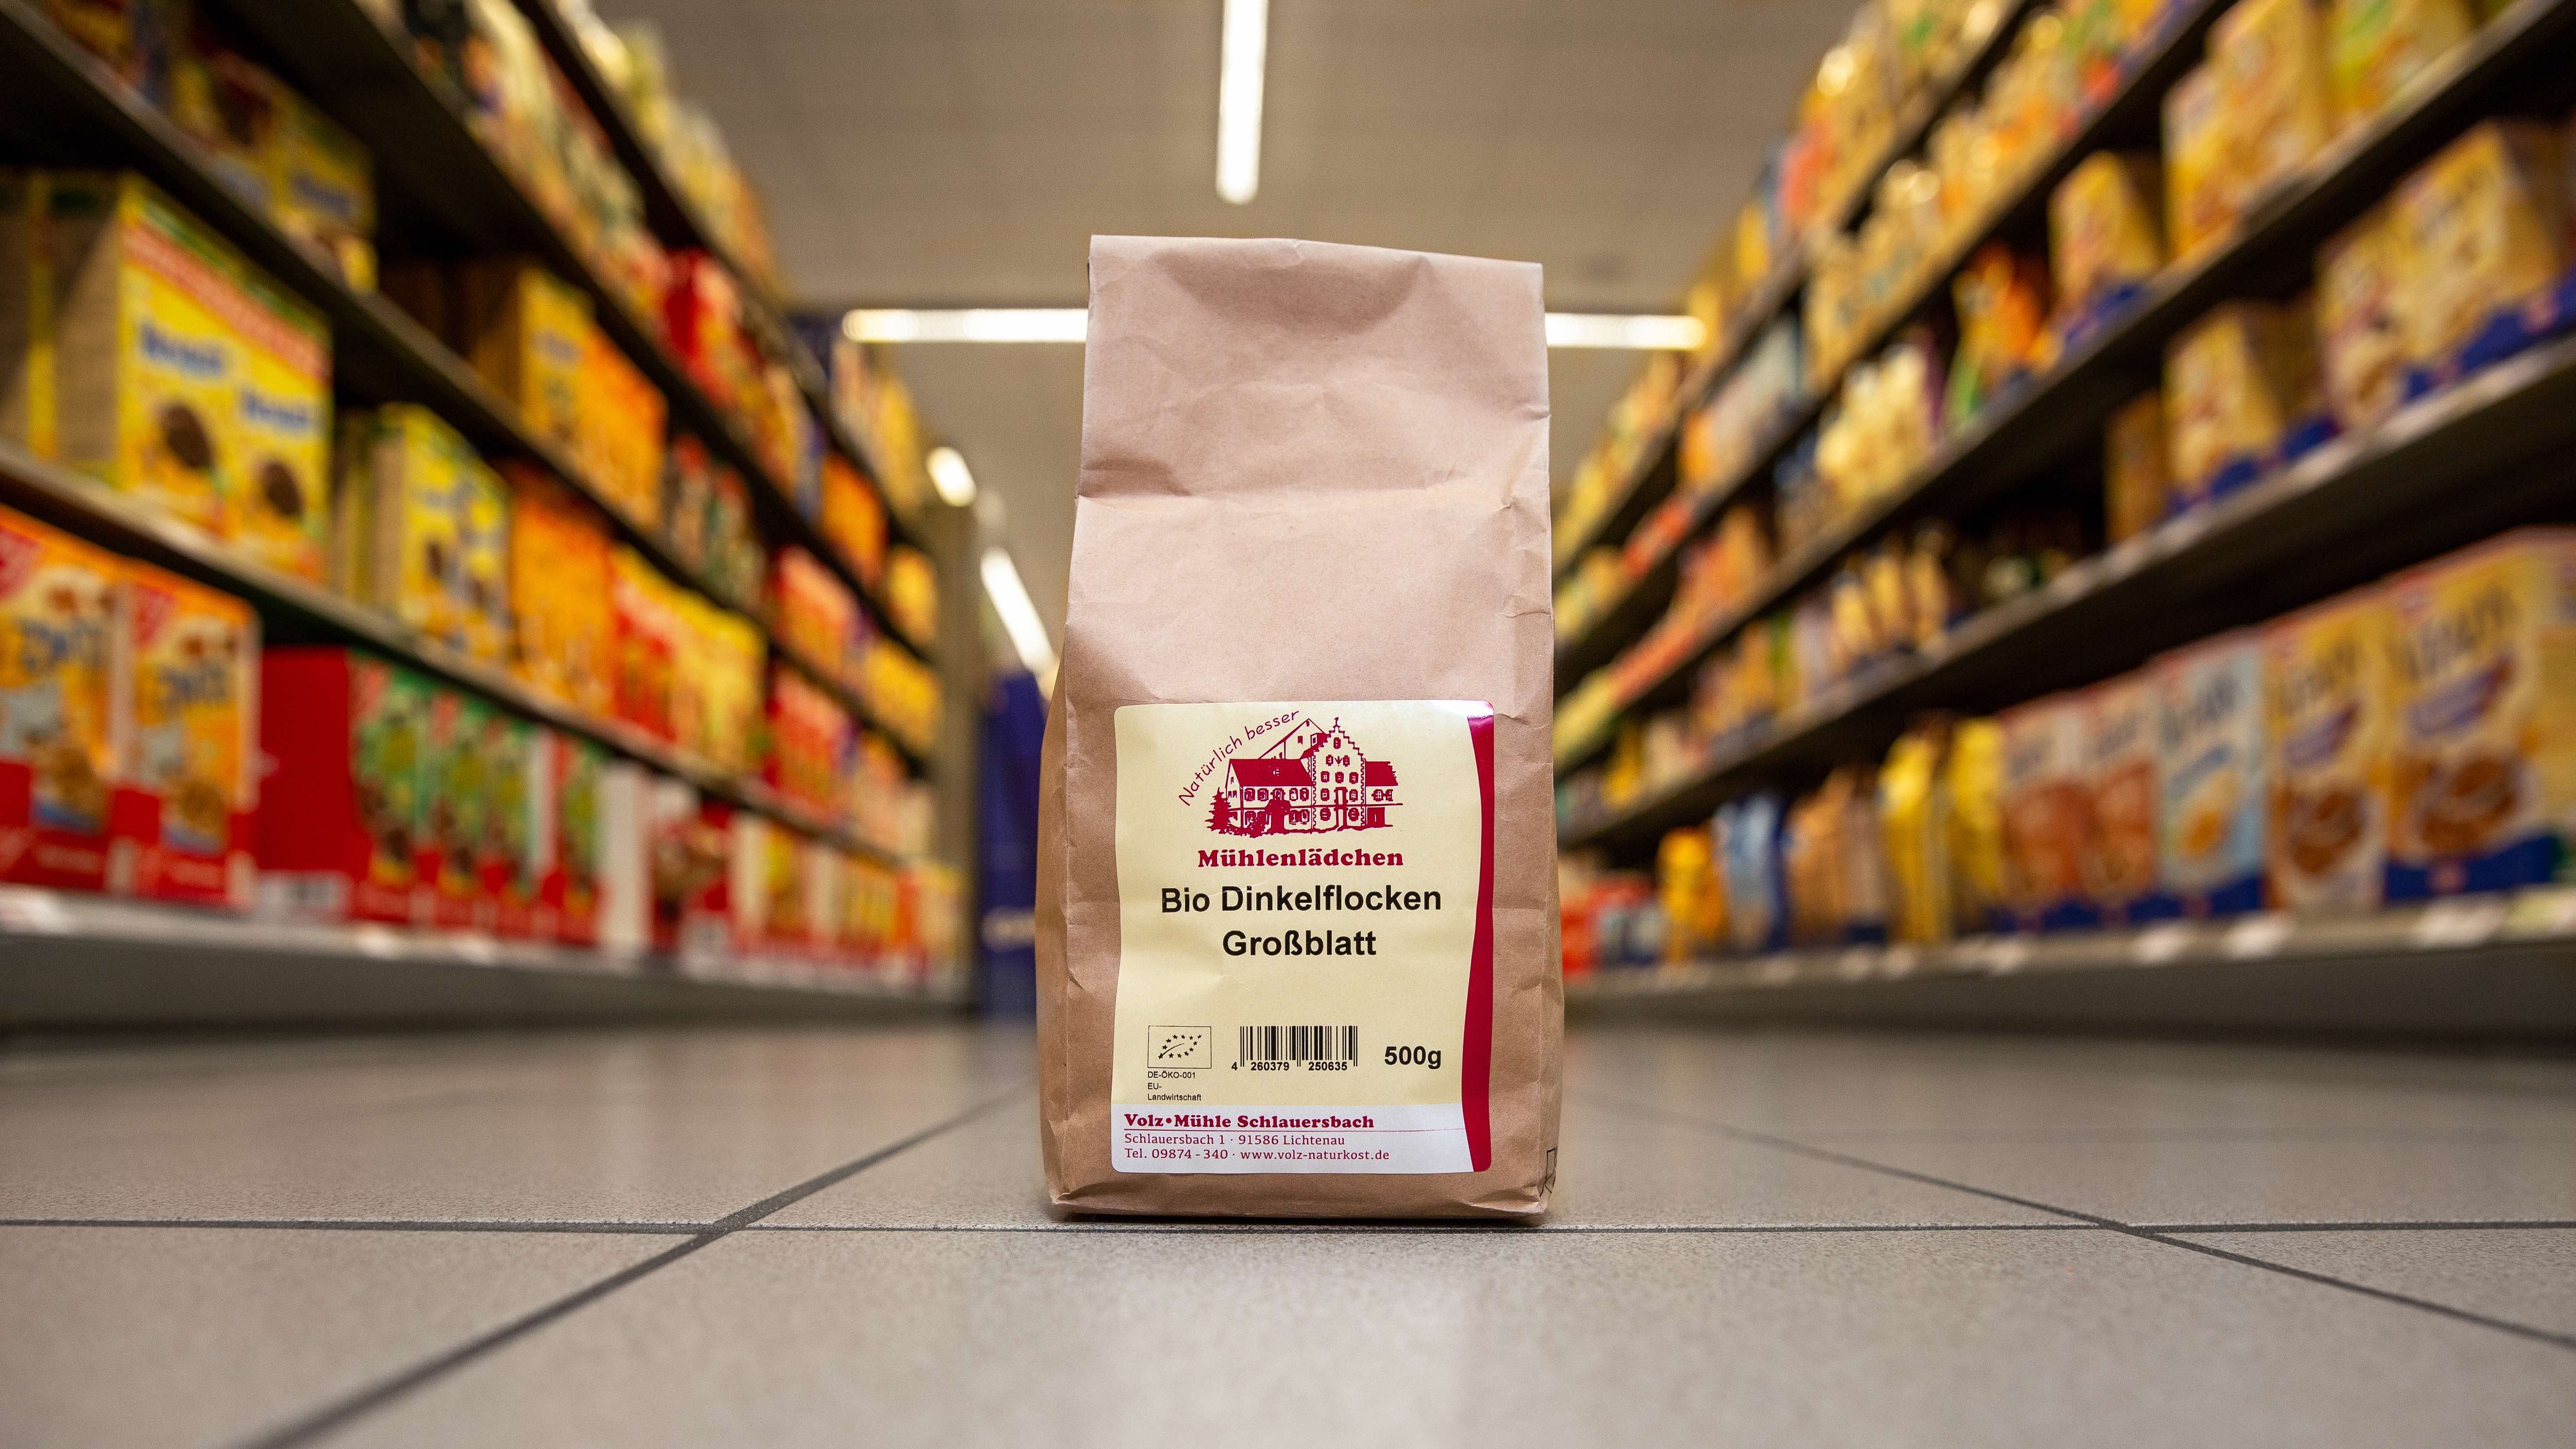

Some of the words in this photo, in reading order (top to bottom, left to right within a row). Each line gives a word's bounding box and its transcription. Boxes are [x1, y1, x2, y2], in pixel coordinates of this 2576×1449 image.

[1178, 735, 1243, 806] Natürlich
[1244, 711, 1299, 740] besser
[1197, 848, 1404, 868] Mühlenlädchen
[1162, 887, 1210, 913] Bio
[1222, 884, 1441, 912] Dinkelflocken
[1223, 930, 1377, 956] Großblatt
[1384, 1046, 1442, 1069] 500g
[1231, 1062, 1238, 1071] 4
[1250, 1062, 1290, 1071] 260379
[1308, 1062, 1348, 1071] 250635
[1147, 1070, 1196, 1079] DE-ÖKO-001
[1147, 1093, 1201, 1101] Landwirtschaft
[1237, 1115, 1375, 1128] Schlauersbach
[1125, 1133, 1214, 1144] Schlauersbach
[1219, 1135, 1225, 1144] 1
[1239, 1135, 1279, 1145] 91586
[1283, 1135, 1345, 1145] Lichtenau
[1124, 1148, 1147, 1158] Tel.
[1151, 1149, 1192, 1159] 09874
[1204, 1149, 1228, 1159] 340
[1240, 1150, 1389, 1160] www.volz-naturkost.de
